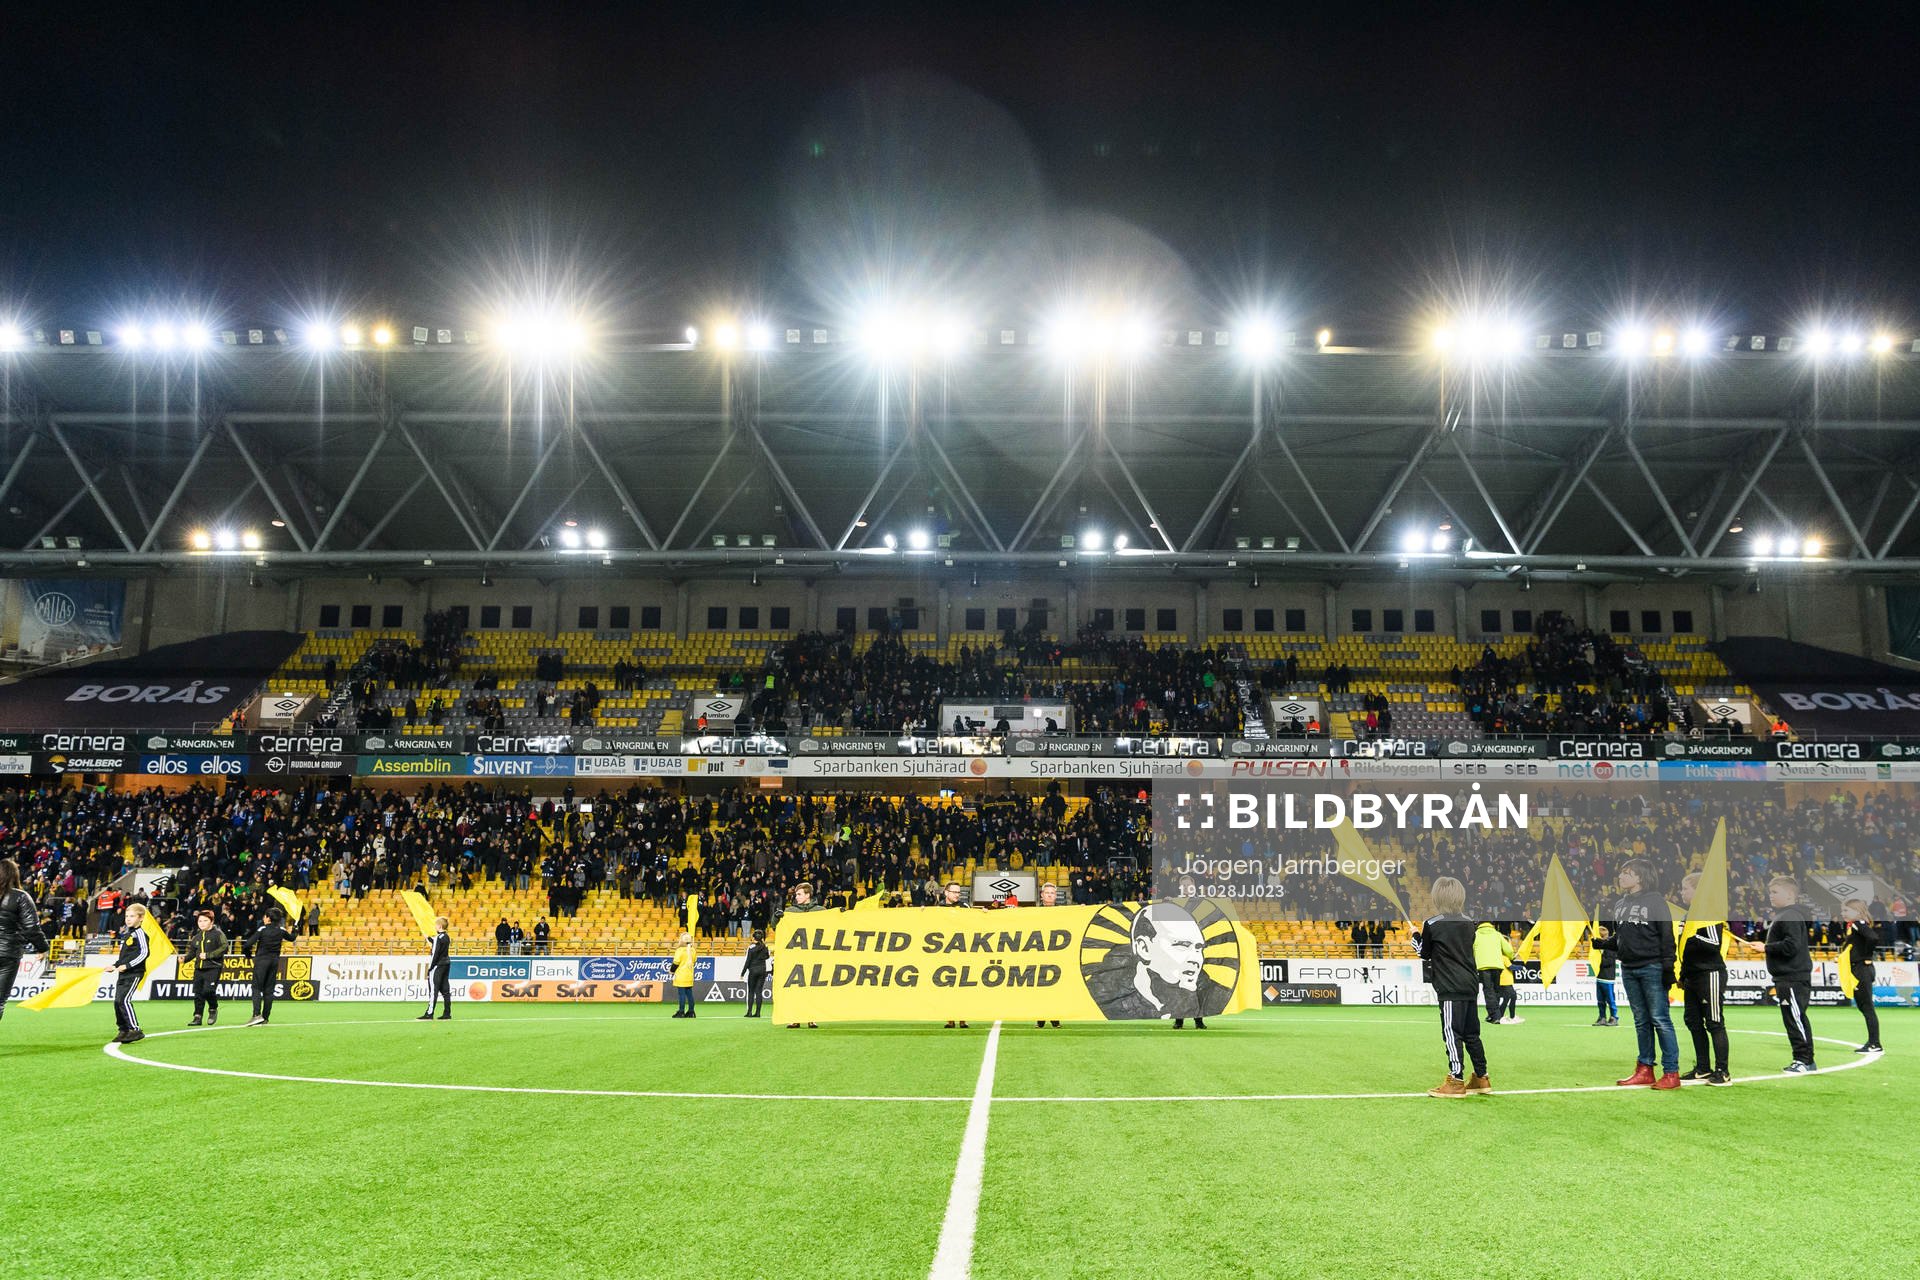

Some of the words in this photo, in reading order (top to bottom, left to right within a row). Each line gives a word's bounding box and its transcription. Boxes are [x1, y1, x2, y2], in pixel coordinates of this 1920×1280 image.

[65, 681, 231, 704] BORÅS
[43, 734, 125, 751] Cernera
[260, 735, 343, 752] Cernera
[478, 736, 561, 753] Cernera
[822, 741, 886, 751] JÄRNGRINDEN
[1254, 743, 1319, 753] JÄRNGRINDEN
[1471, 744, 1535, 754] JÄRNGRINDEN
[1560, 741, 1643, 757] Cernera
[1688, 744, 1752, 755] JÄRNGRINDEN
[1776, 742, 1860, 759] Cernera
[67, 759, 123, 767] SOHLBERG
[147, 755, 187, 774] ellos
[200, 755, 241, 774] ellos
[290, 761, 320, 769] RUDHOLM
[321, 761, 342, 769] GROUP
[372, 758, 451, 773] Assemblin
[473, 757, 533, 776] SILVENT
[594, 758, 626, 767] UBAB
[650, 758, 682, 768] UBAB
[814, 760, 898, 776] Sparbanken
[903, 760, 966, 776] Sjuhärad
[1030, 760, 1115, 776] Sparbanken
[1119, 761, 1183, 776] Sjuhärad
[1231, 761, 1327, 777] PULSEN
[1354, 761, 1435, 777] Riksbyggen
[1454, 764, 1487, 775] SEB
[1504, 764, 1538, 775] SEB
[1558, 761, 1592, 778] net
[1616, 761, 1650, 779] net
[784, 927, 912, 953] ALLTID
[921, 929, 1072, 954] SAKNAD
[327, 963, 429, 980] Sandwall
[467, 965, 526, 977] Danske
[535, 964, 574, 977] Bank
[626, 959, 673, 973] Sjömarke
[783, 964, 920, 988] ALDRIG
[931, 959, 1062, 988] GLÖMD
[1260, 965, 1283, 981] ion
[1300, 967, 1388, 980] FRONT
[1729, 969, 1767, 980] SLAND
[156, 983, 171, 997] VI
[324, 983, 401, 999] Sparbanken
[407, 983, 466, 998] Sjuad
[501, 984, 542, 998] SIXT
[556, 984, 597, 998] SIXT
[613, 984, 653, 998] SIXT
[1280, 988, 1337, 1000] SPLITVISION
[1372, 985, 1399, 1004] aki
[1516, 988, 1592, 1003] Sparbanken
